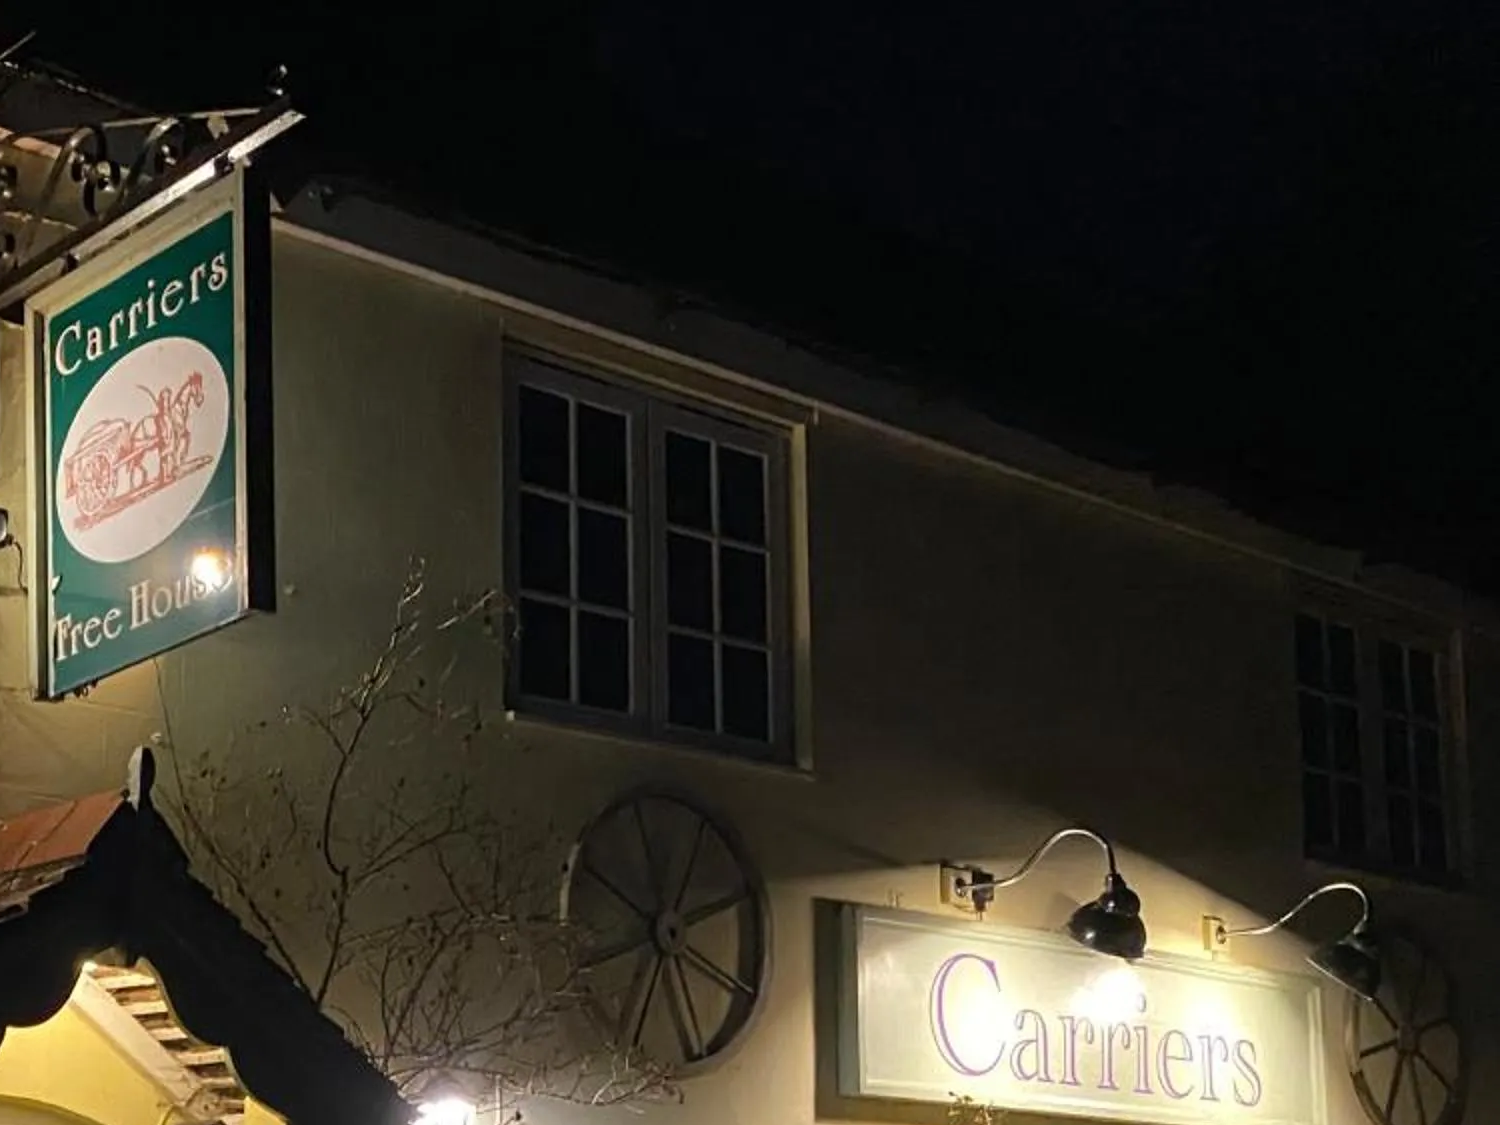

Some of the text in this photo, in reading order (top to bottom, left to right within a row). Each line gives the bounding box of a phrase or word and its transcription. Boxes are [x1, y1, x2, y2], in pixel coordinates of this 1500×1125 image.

[55, 250, 228, 378] Carriers
[56, 607, 122, 661] Free
[929, 953, 1263, 1107] Carriers
